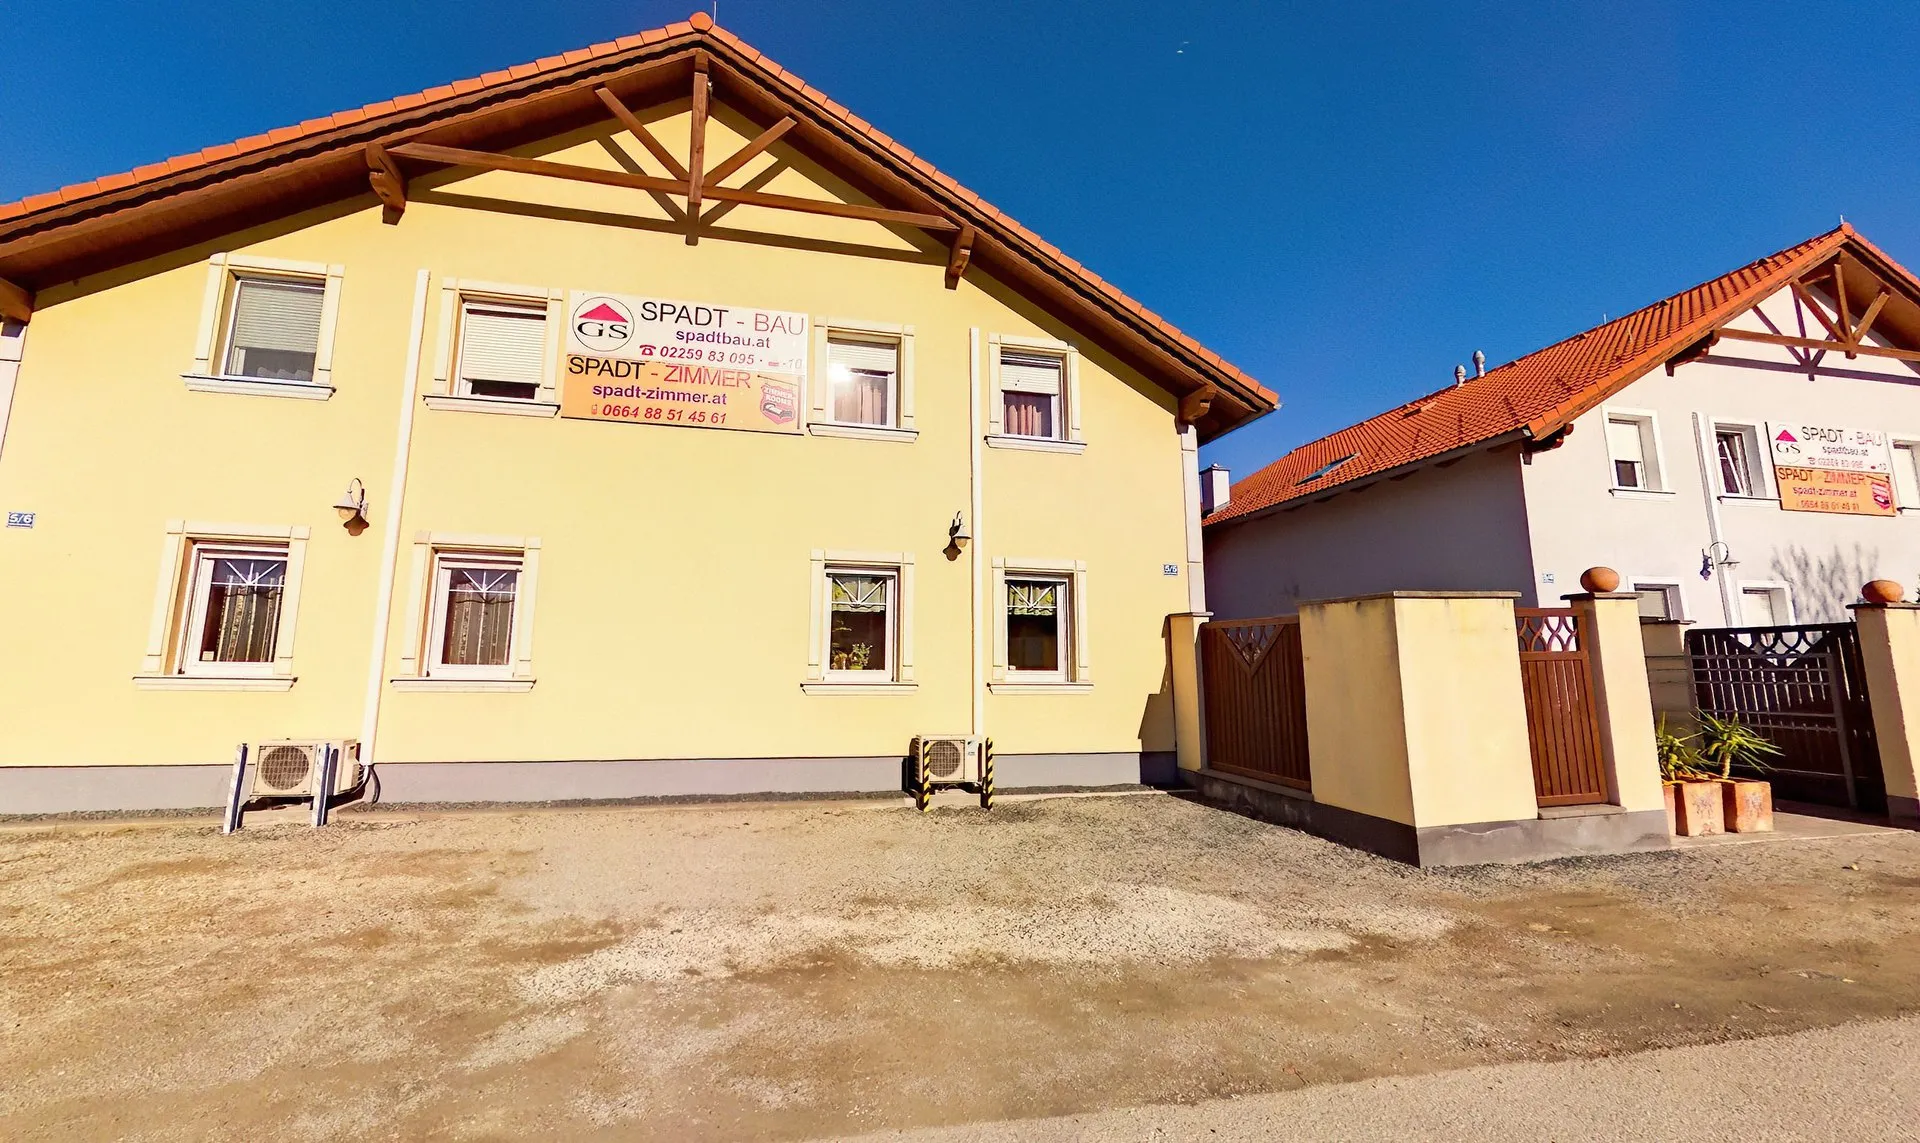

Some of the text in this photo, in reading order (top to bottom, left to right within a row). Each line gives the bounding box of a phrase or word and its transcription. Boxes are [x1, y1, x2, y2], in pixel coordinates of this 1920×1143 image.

[641, 302, 728, 328] SPADT
[754, 313, 804, 336] BAU
[577, 322, 628, 340] GS
[676, 329, 770, 348] spadtbau.at
[660, 346, 702, 360] 02259
[708, 350, 724, 363] 83
[729, 352, 754, 365] 095
[568, 356, 645, 380] SPADT
[664, 365, 751, 388] ZIMMER
[592, 384, 727, 406] spadt-zimmer.at
[602, 404, 726, 424] 0664 88 51 45 61
[1801, 426, 1844, 443] SPADT
[1776, 442, 1801, 454] GS
[1778, 467, 1813, 482] SPADT
